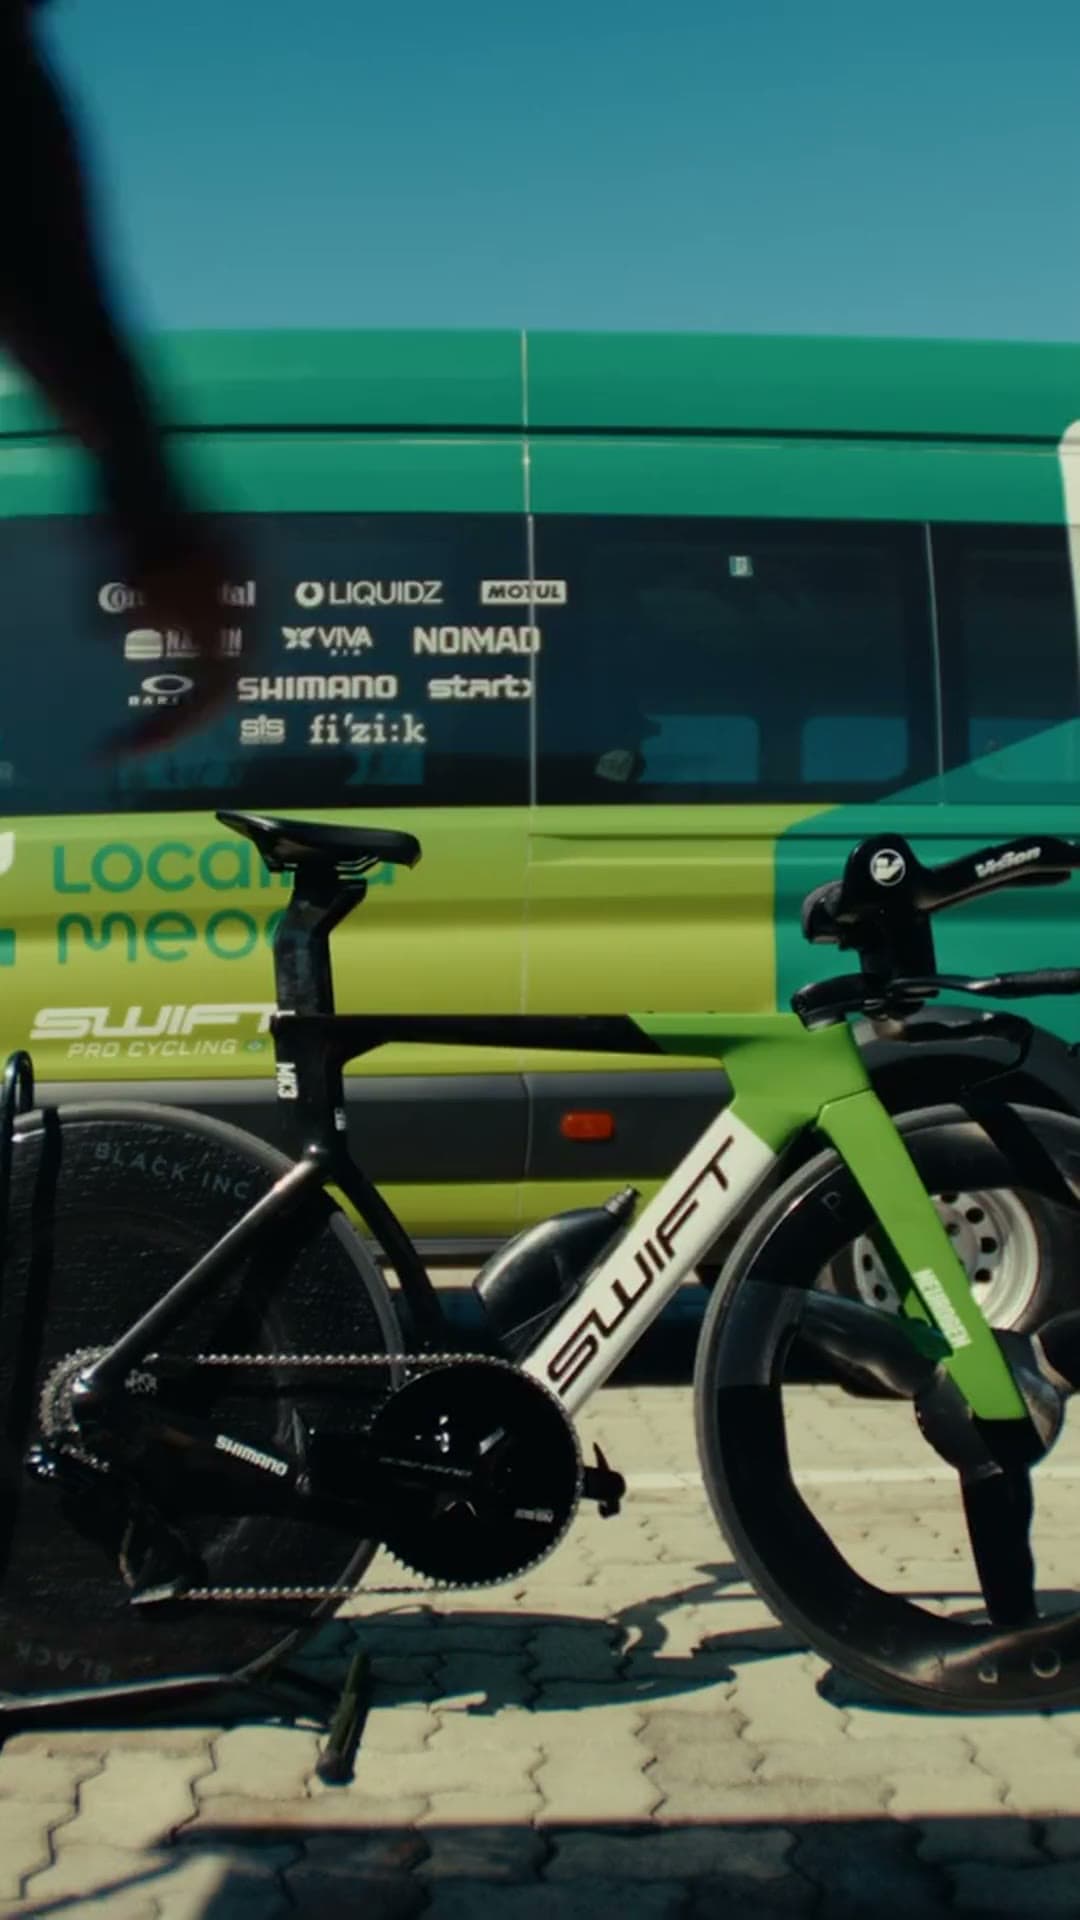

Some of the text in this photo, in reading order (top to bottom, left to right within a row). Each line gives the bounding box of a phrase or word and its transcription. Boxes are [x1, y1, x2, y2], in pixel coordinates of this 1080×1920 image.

[329, 580, 442, 606] LIQUIDZ
[486, 582, 562, 600] MOTUL
[318, 625, 373, 649] VIVA
[413, 626, 541, 655] NOMAD
[237, 675, 398, 701] SHIMANO
[30, 1002, 281, 1040] SWIFT
[67, 1038, 240, 1059] PRO CYCLING
[94, 1141, 250, 1200] BLACK INC
[546, 1134, 736, 1396] SWIFT
[214, 1433, 289, 1477] SHIMANO
